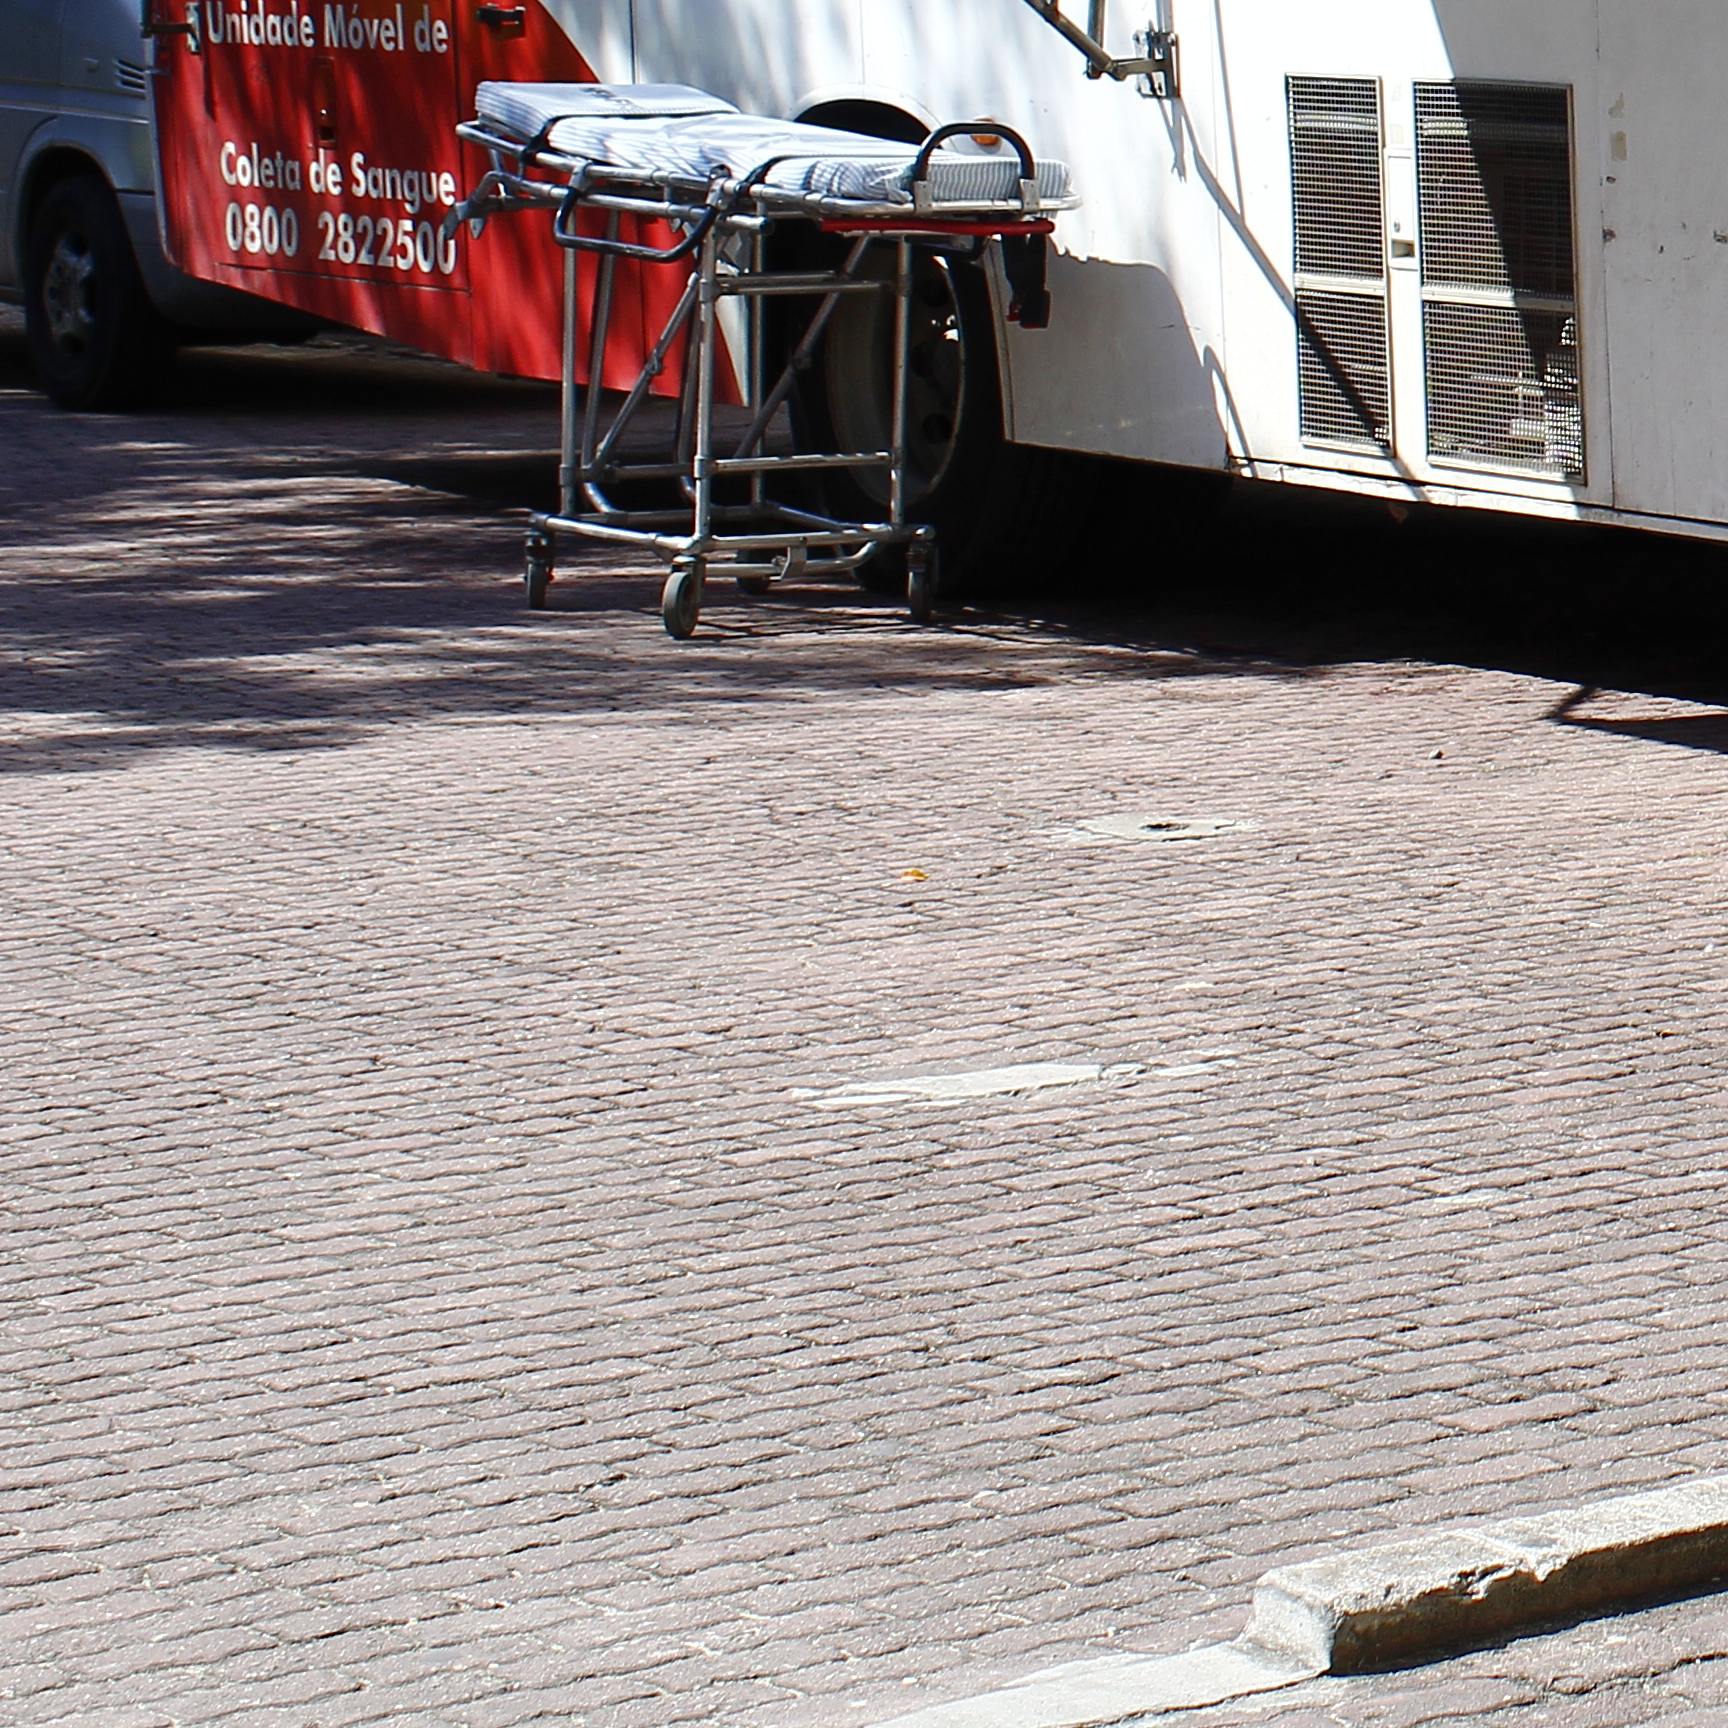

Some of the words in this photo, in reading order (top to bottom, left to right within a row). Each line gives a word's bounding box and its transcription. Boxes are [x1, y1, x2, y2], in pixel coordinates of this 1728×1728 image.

[323, 3, 404, 52] Móvel
[413, 4, 449, 54] de
[220, 141, 301, 191] Coleta
[309, 147, 343, 195] de
[351, 151, 456, 215] Sangue
[225, 202, 299, 258] 0800
[318, 210, 457, 275] 2822500
